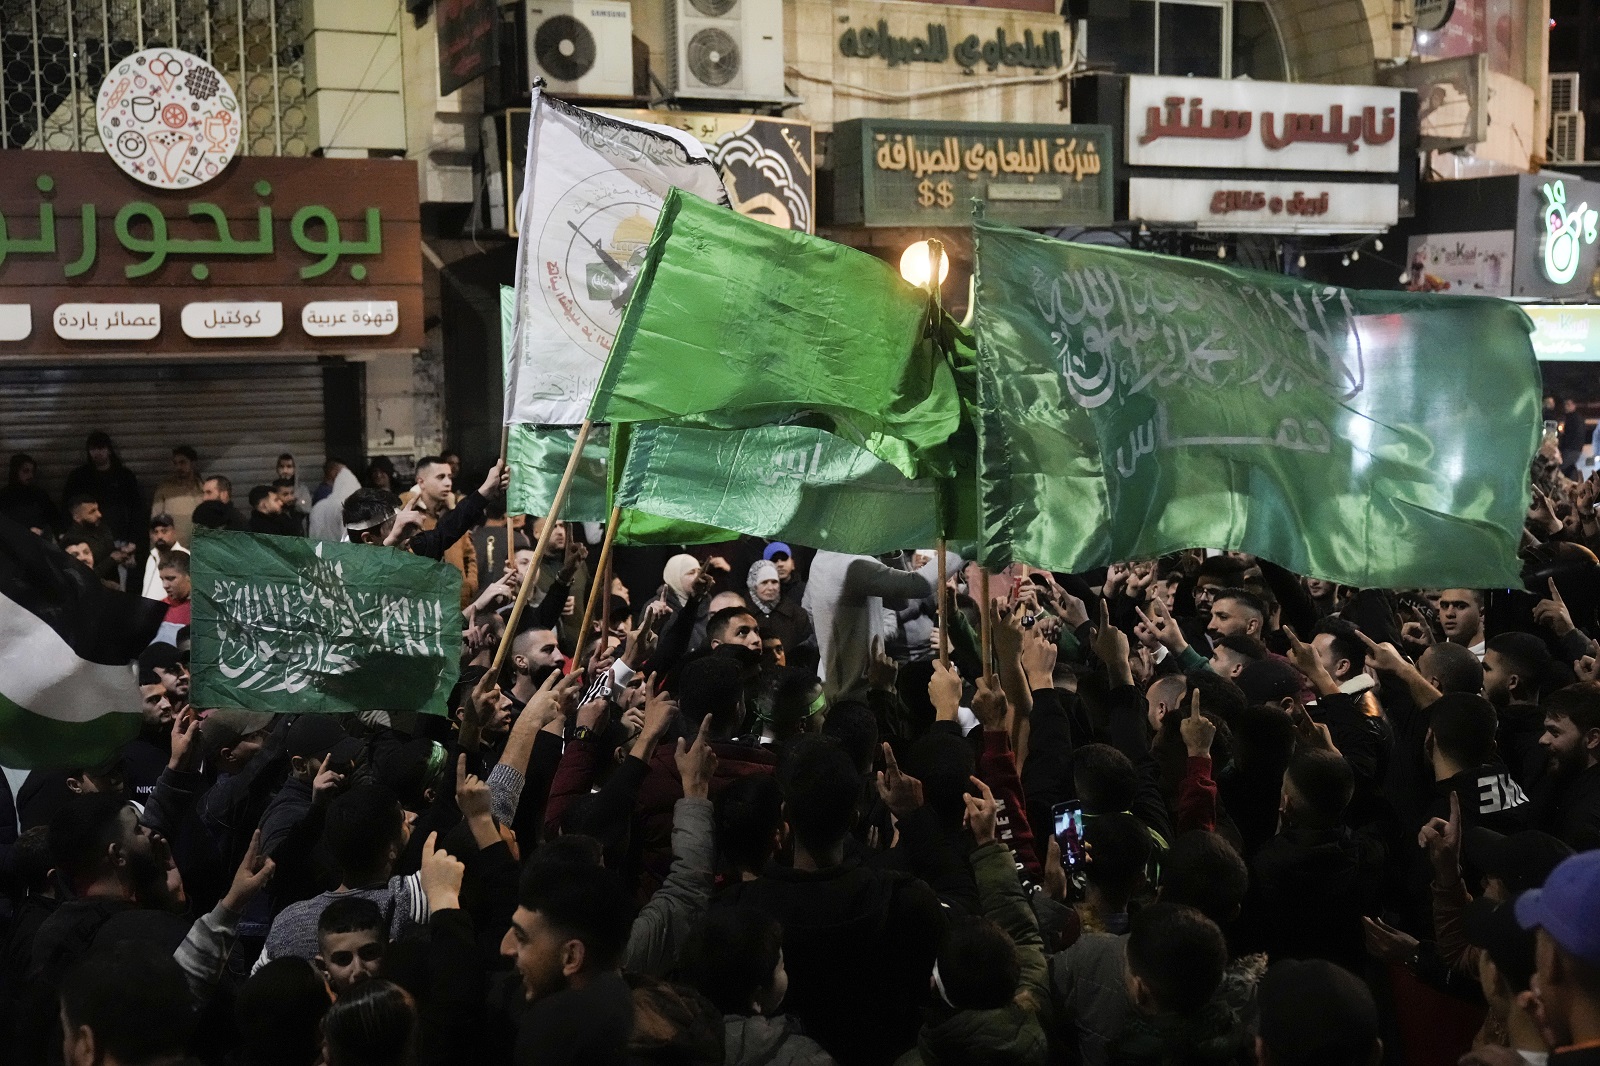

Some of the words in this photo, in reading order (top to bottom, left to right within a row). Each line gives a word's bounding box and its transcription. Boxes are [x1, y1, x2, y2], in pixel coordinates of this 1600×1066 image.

[591, 9, 627, 18] SAMSUNG
[954, 27, 1063, 75] البلعاوي
[1137, 96, 1252, 146] سنتر
[1260, 104, 1395, 155] نابلس
[875, 133, 960, 178] للصرافة
[964, 138, 1049, 183] البلعاوي
[1053, 138, 1101, 181] شركة
[917, 178, 954, 208] $$
[0, 173, 383, 281] بونجورن
[58, 310, 98, 331] باردة
[105, 311, 157, 330] عصائر
[204, 309, 262, 329] كوكتيل
[307, 310, 347, 327] عربية
[352, 309, 394, 327] قهوة
[1116, 397, 1331, 478] حماس
[1399, 597, 1434, 621] NIKE
[136, 785, 156, 794] NIK
